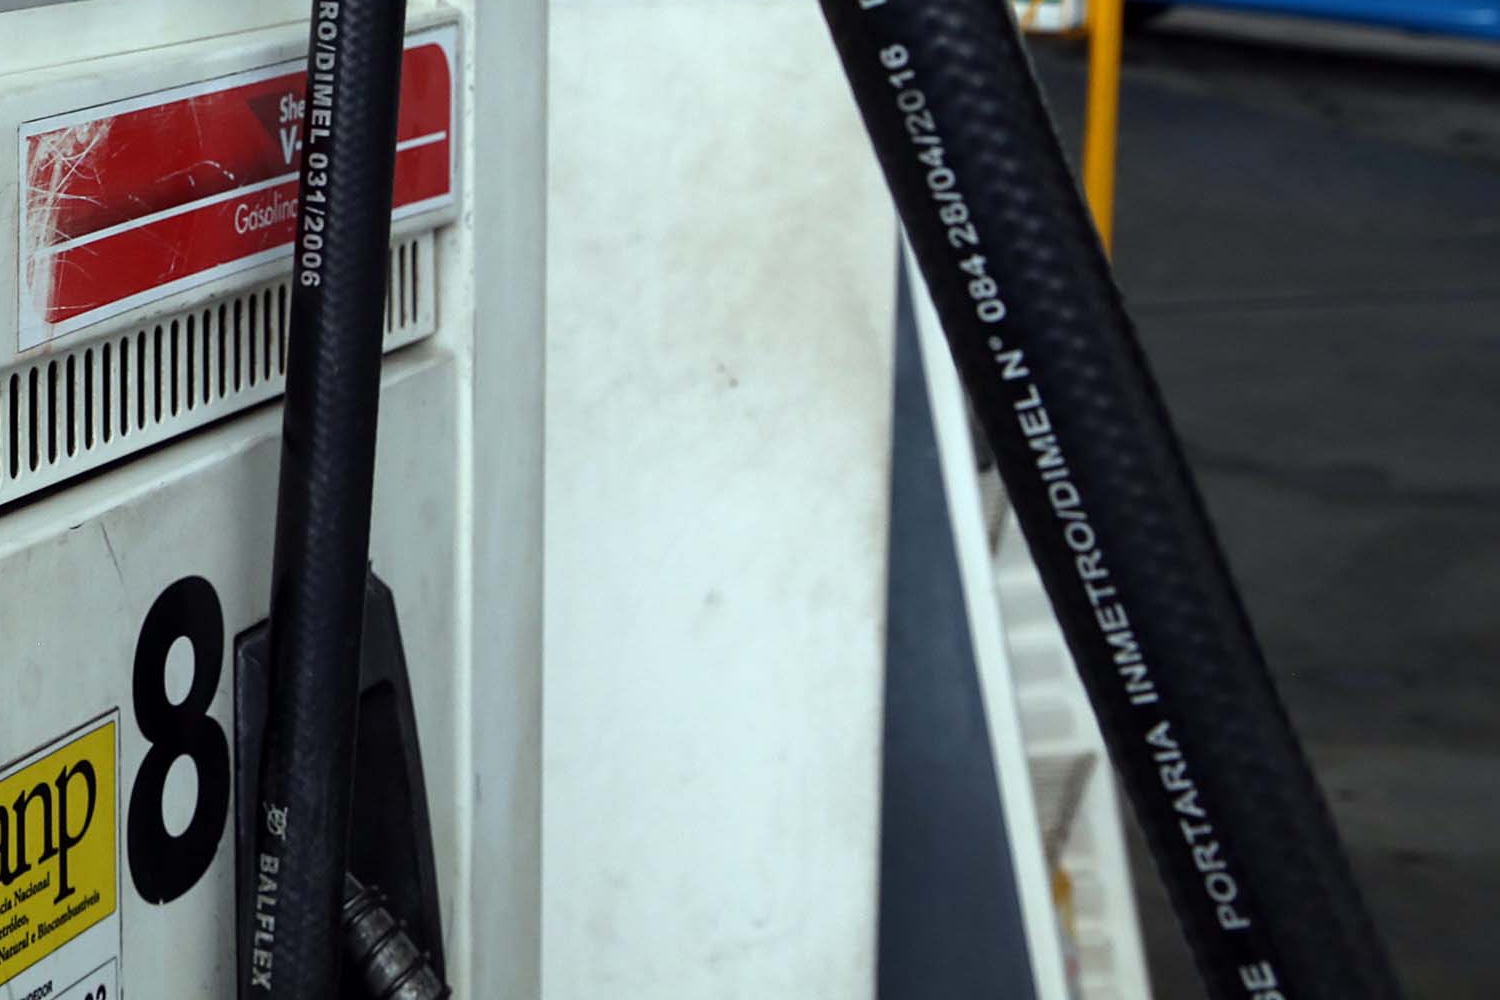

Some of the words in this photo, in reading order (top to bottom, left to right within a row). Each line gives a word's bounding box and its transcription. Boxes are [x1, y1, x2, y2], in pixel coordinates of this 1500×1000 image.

[300, 152, 328, 287] 031/2006
[880, 43, 979, 248] 28/04/2016
[959, 254, 1006, 323] 084
[1013, 383, 1158, 704] INMETRO/DIMEL
[127, 574, 231, 906] 8
[1146, 720, 1251, 930] PORTARIA
[13, 871, 50, 908] Nacional
[252, 853, 279, 991] BALFLEX
